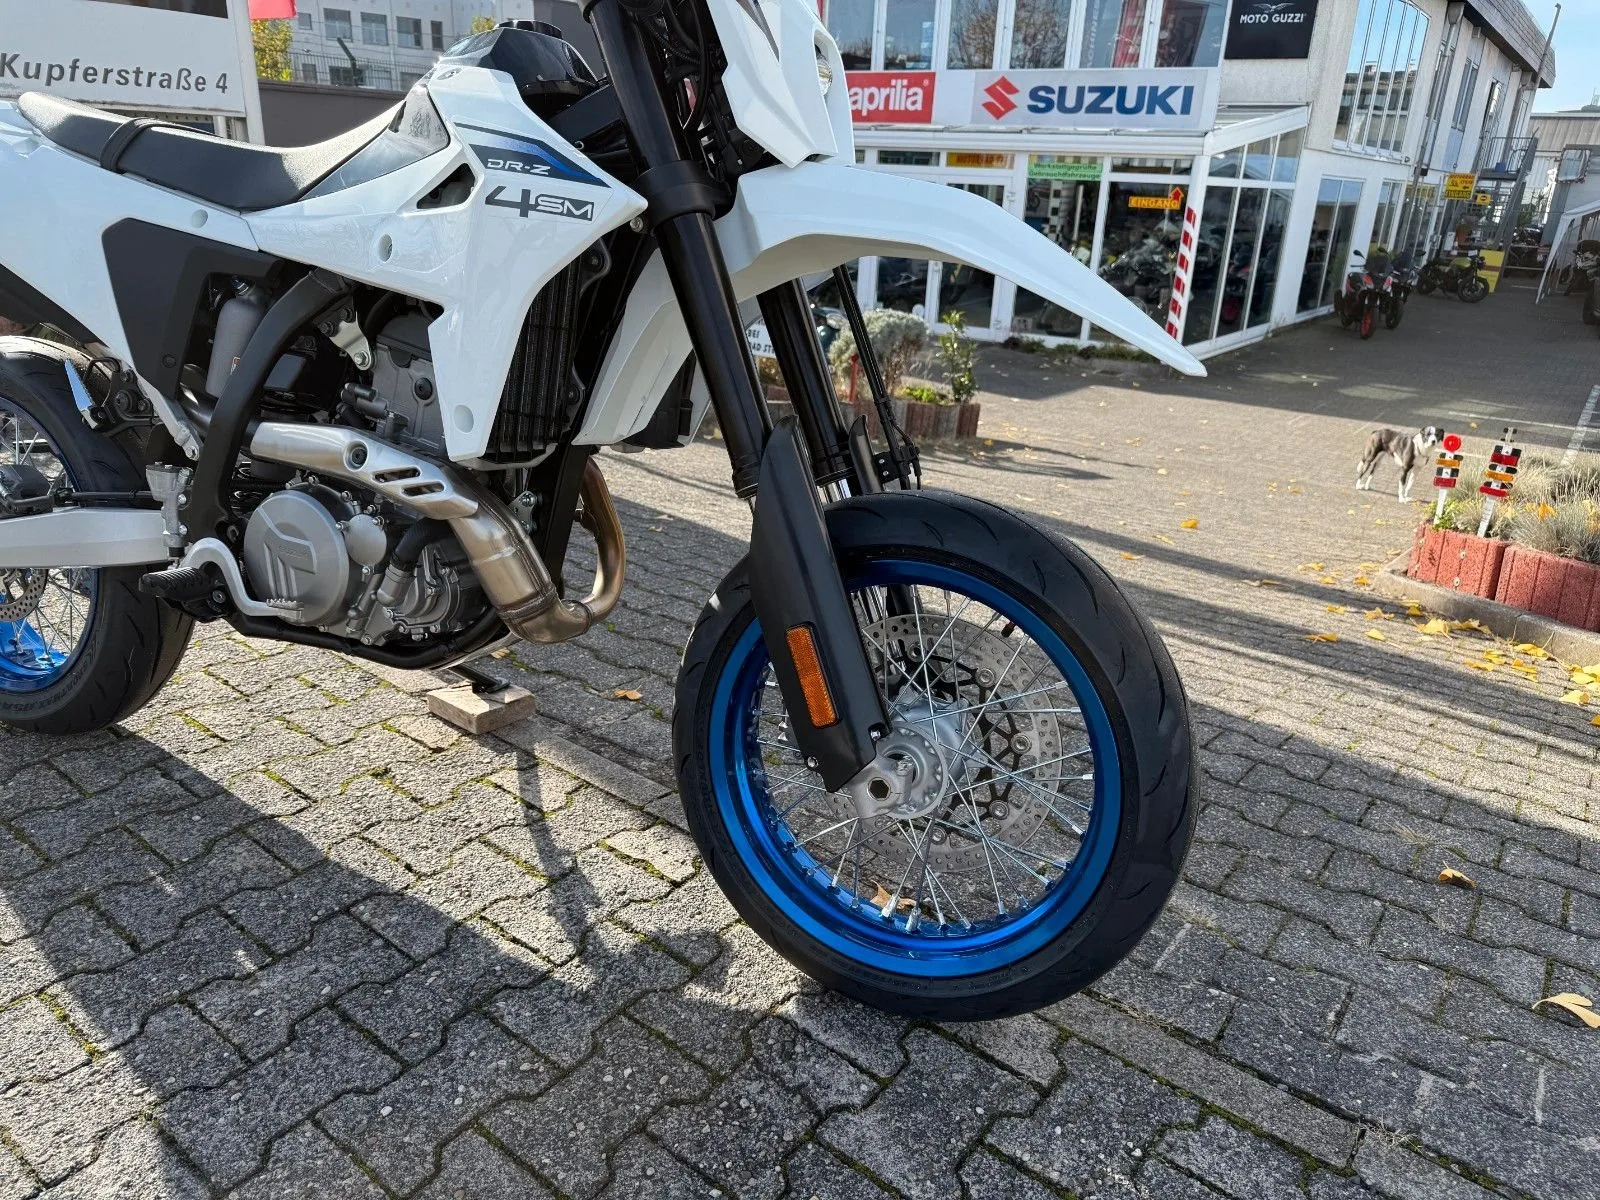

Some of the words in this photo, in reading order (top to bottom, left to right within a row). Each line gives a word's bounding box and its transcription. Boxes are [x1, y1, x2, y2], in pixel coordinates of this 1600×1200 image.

[1240, 14, 1268, 24] MOTO
[1271, 13, 1304, 23] GUZZI
[0, 53, 207, 92] Kupferstraße
[215, 72, 228, 94] 4
[849, 79, 923, 117] aprilia
[1026, 85, 1195, 115] SUZUKI
[487, 158, 551, 176] DR-Z
